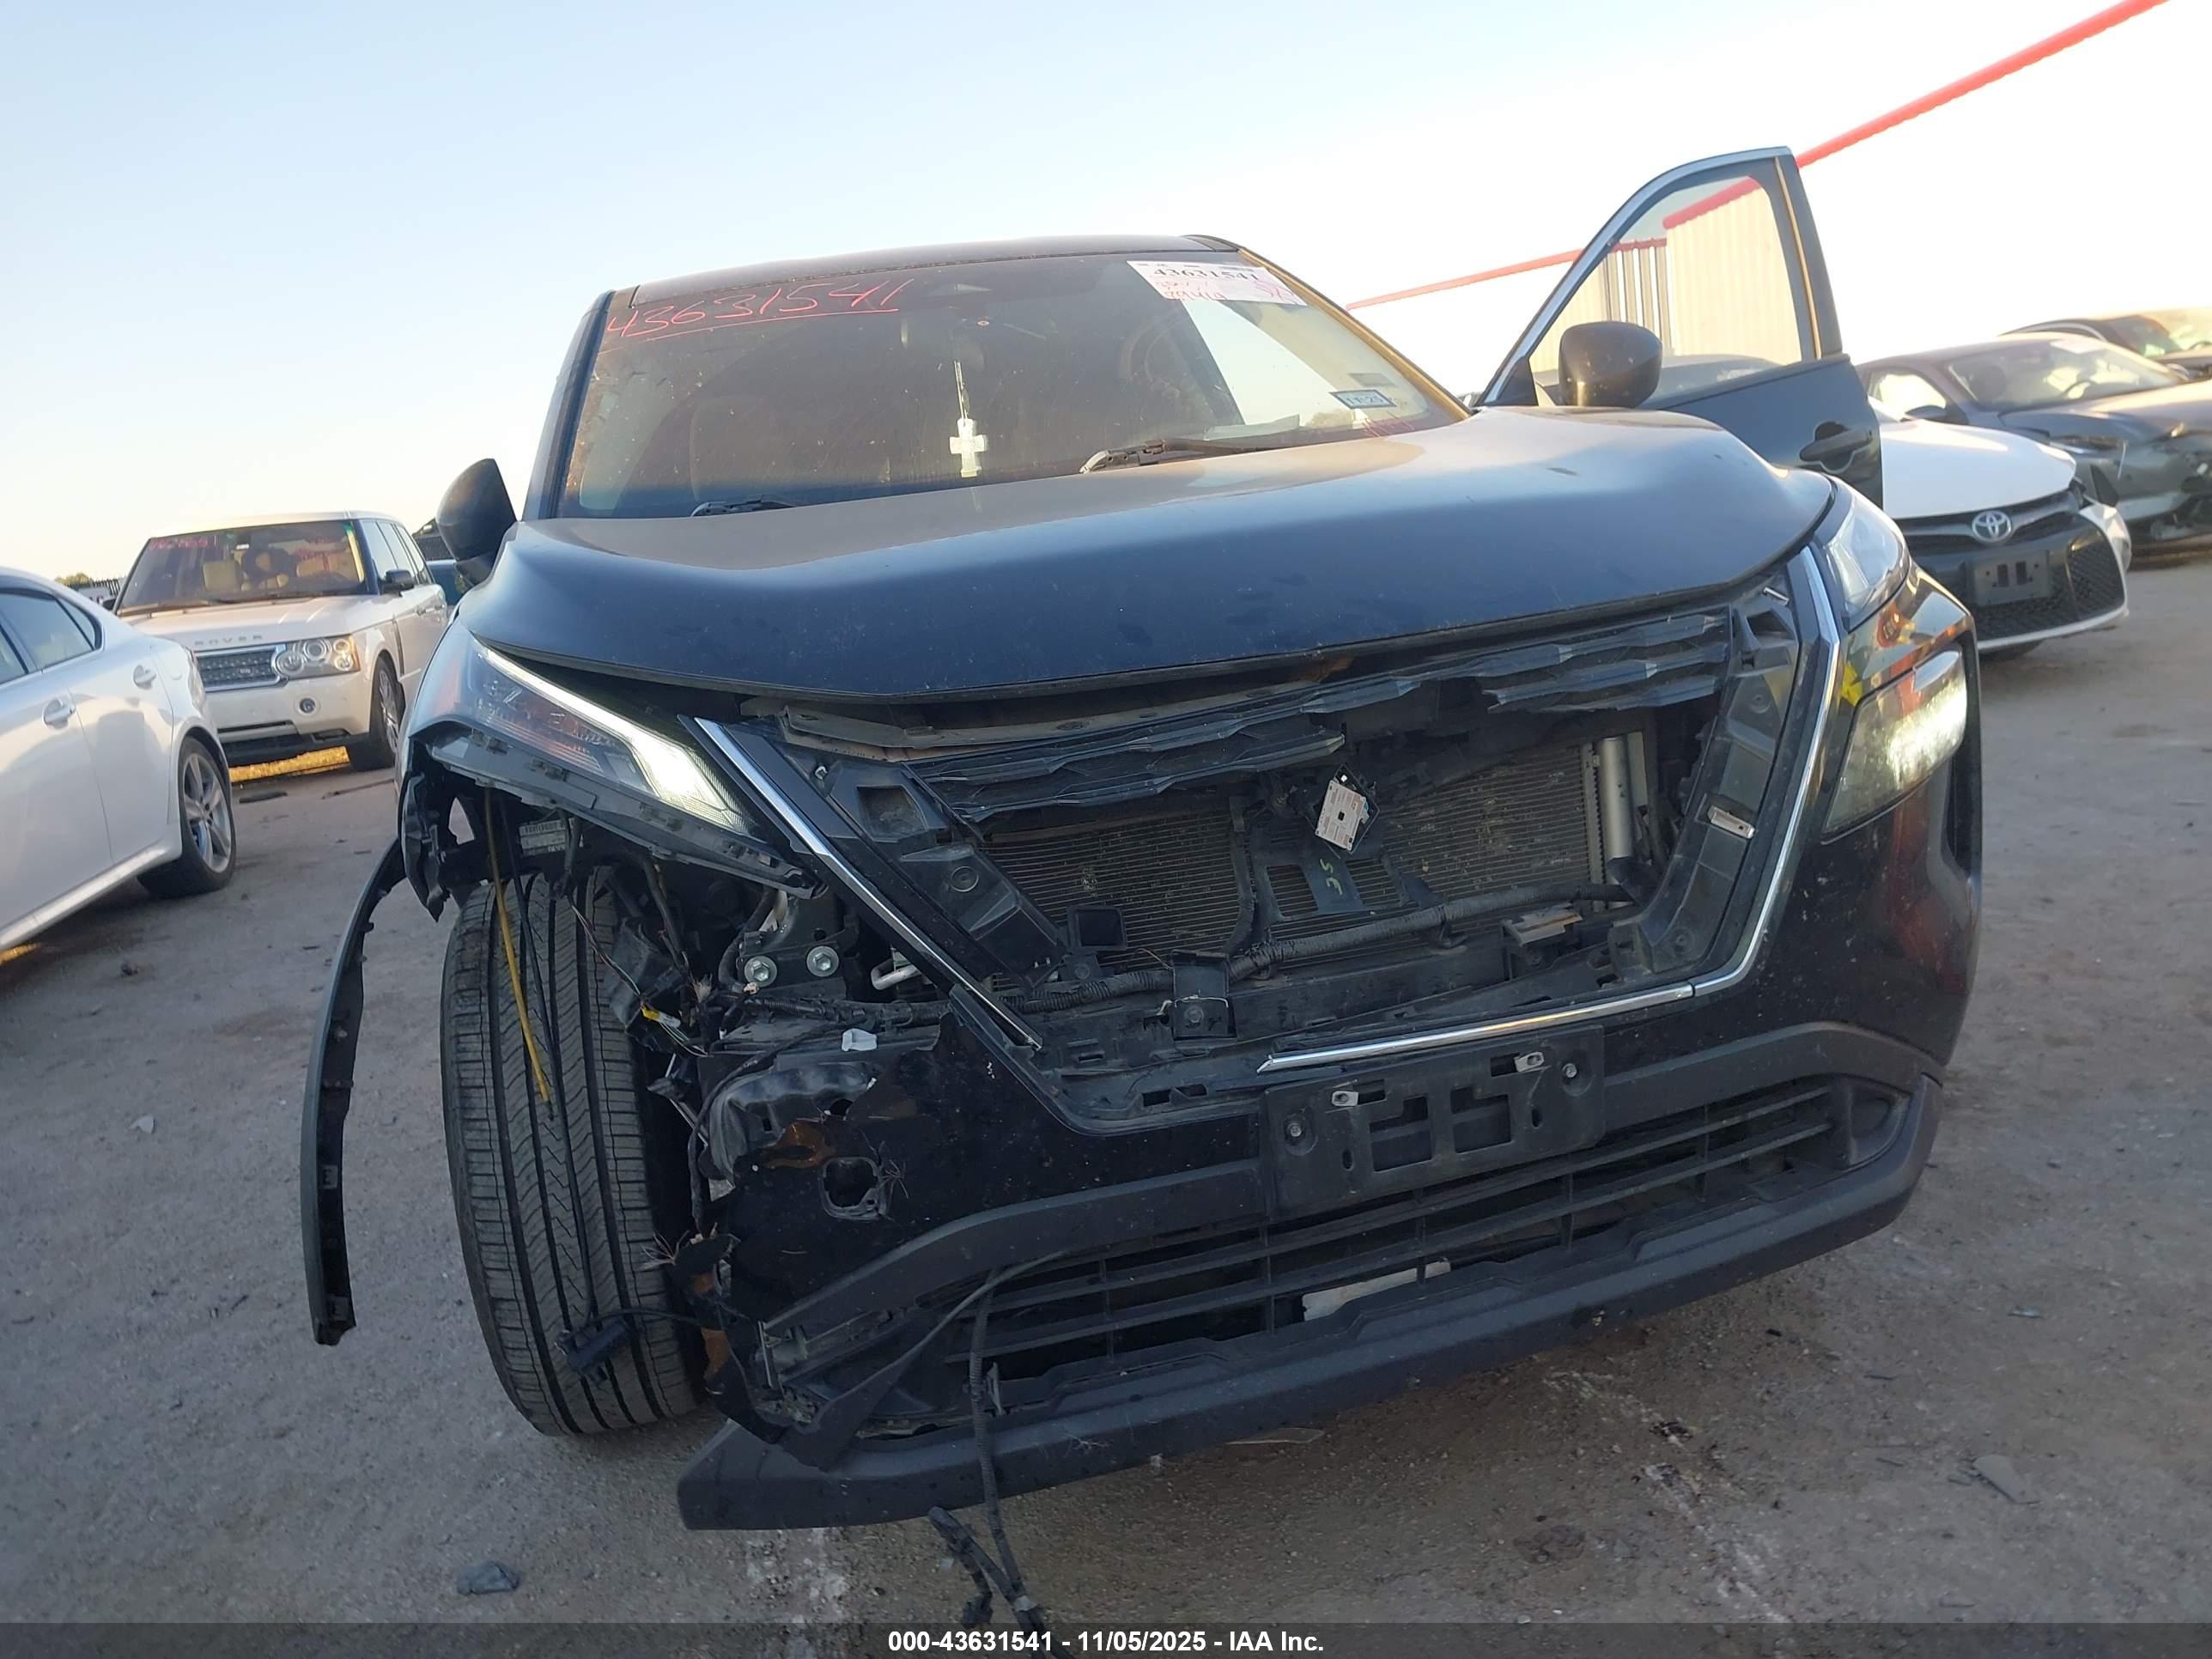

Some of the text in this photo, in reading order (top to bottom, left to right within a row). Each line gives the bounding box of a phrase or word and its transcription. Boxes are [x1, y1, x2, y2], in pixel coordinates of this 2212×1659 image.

[1153, 267, 1260, 281] 43631541
[607, 277, 915, 337] 43631541
[194, 635, 264, 647] ROVER
